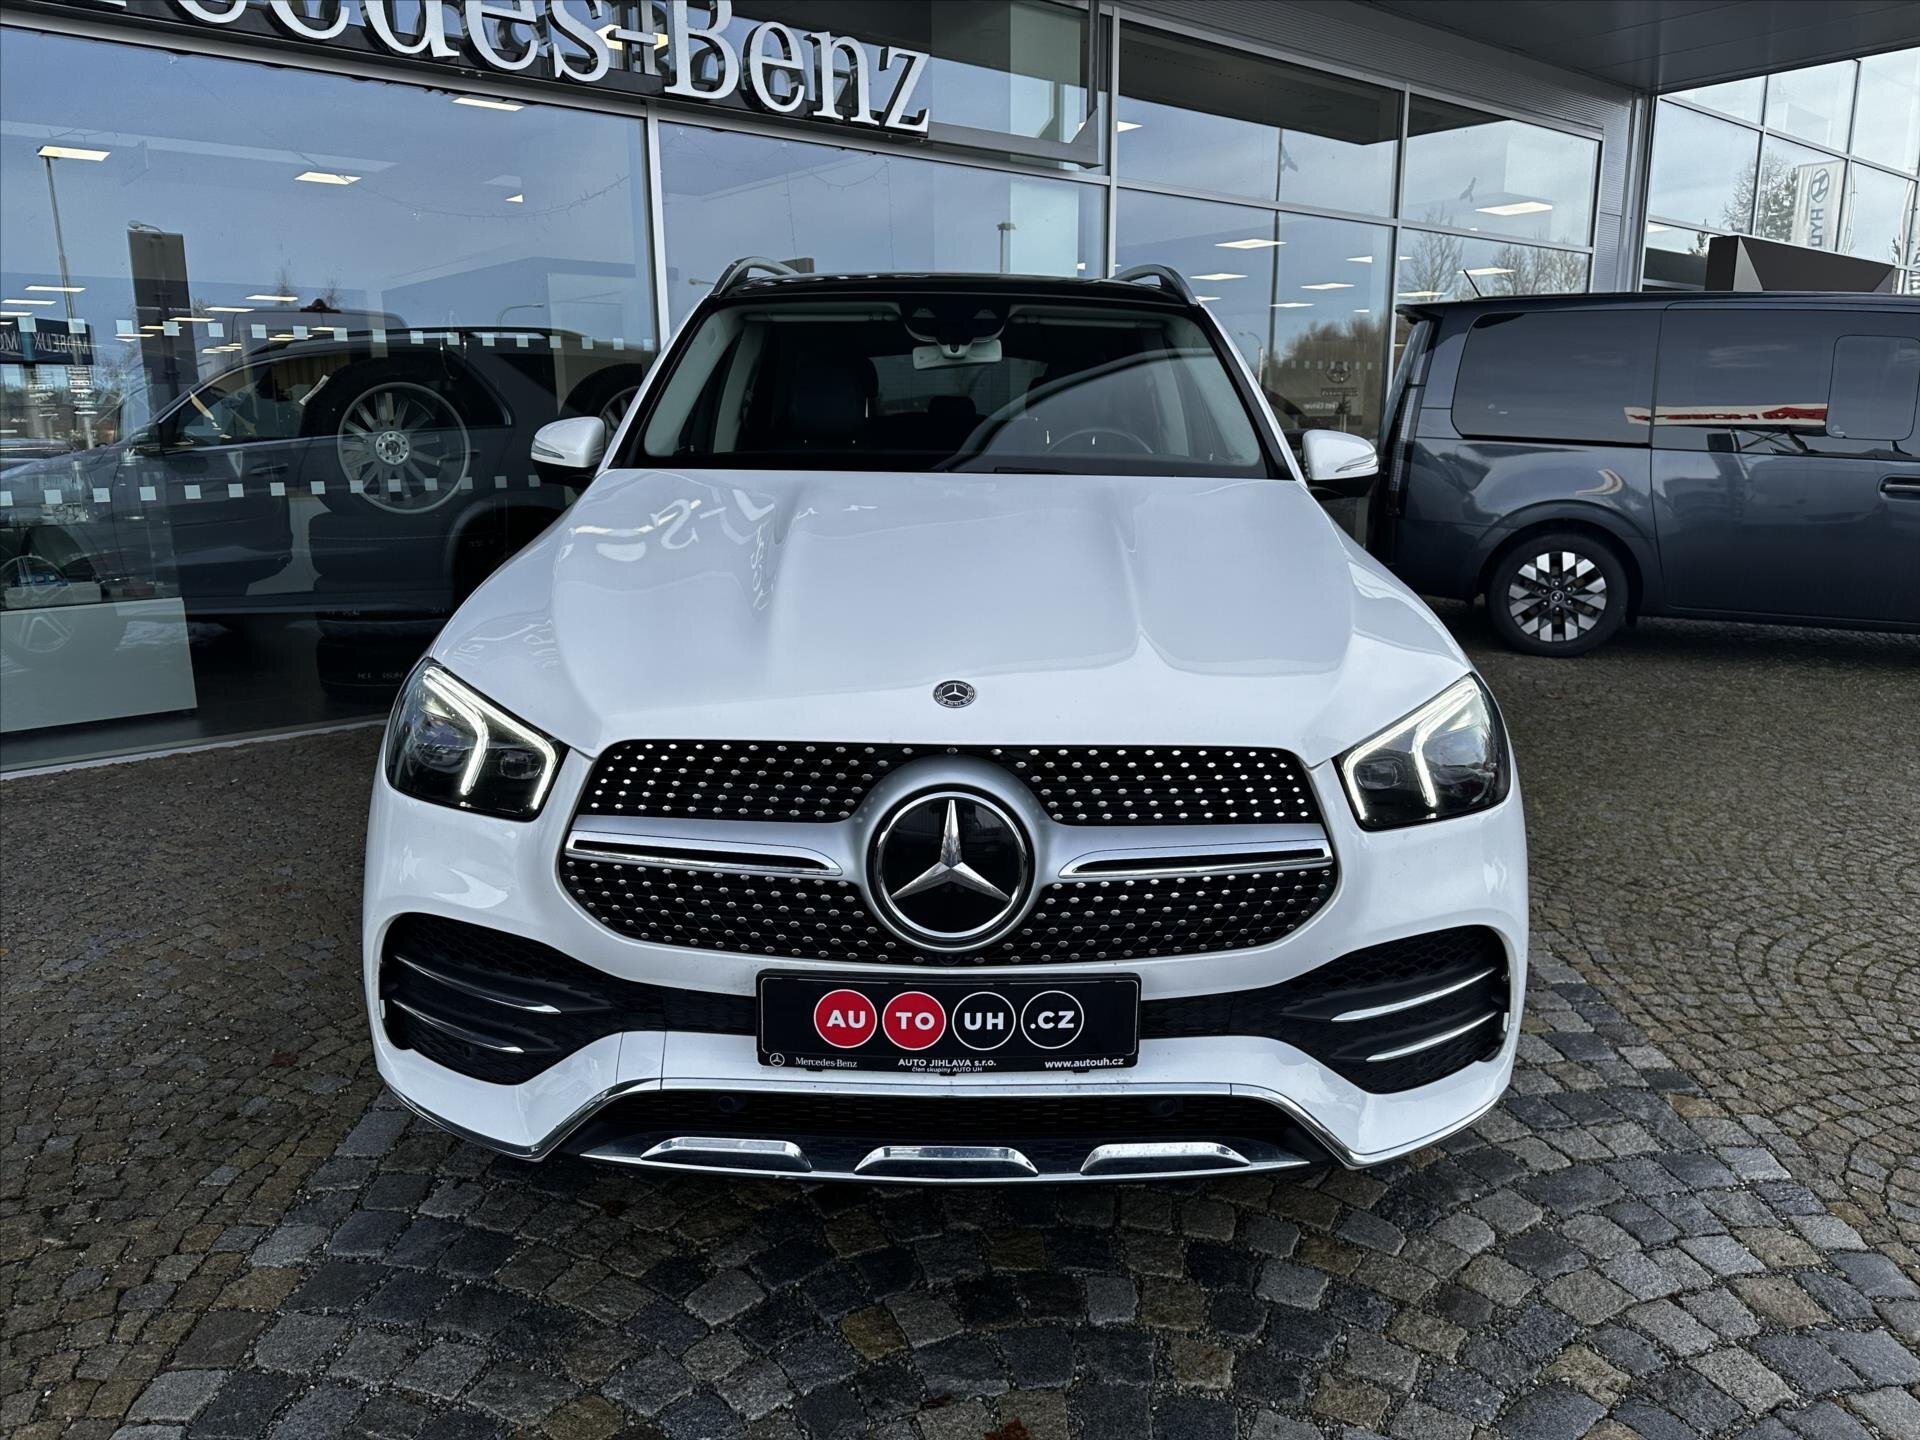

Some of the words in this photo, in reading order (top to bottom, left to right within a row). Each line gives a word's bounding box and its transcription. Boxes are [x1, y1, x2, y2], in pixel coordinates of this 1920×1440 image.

[827, 1010, 866, 1029] AU
[896, 1012, 935, 1030] TO
[964, 1012, 1004, 1030] UH
[1030, 1011, 1075, 1029] .CZ
[795, 1056, 858, 1068] Mercedes-Benz
[898, 1059, 927, 1067] AUTO
[929, 1059, 971, 1067] JIHLAVA
[1045, 1057, 1124, 1069] www.autouh.cz
